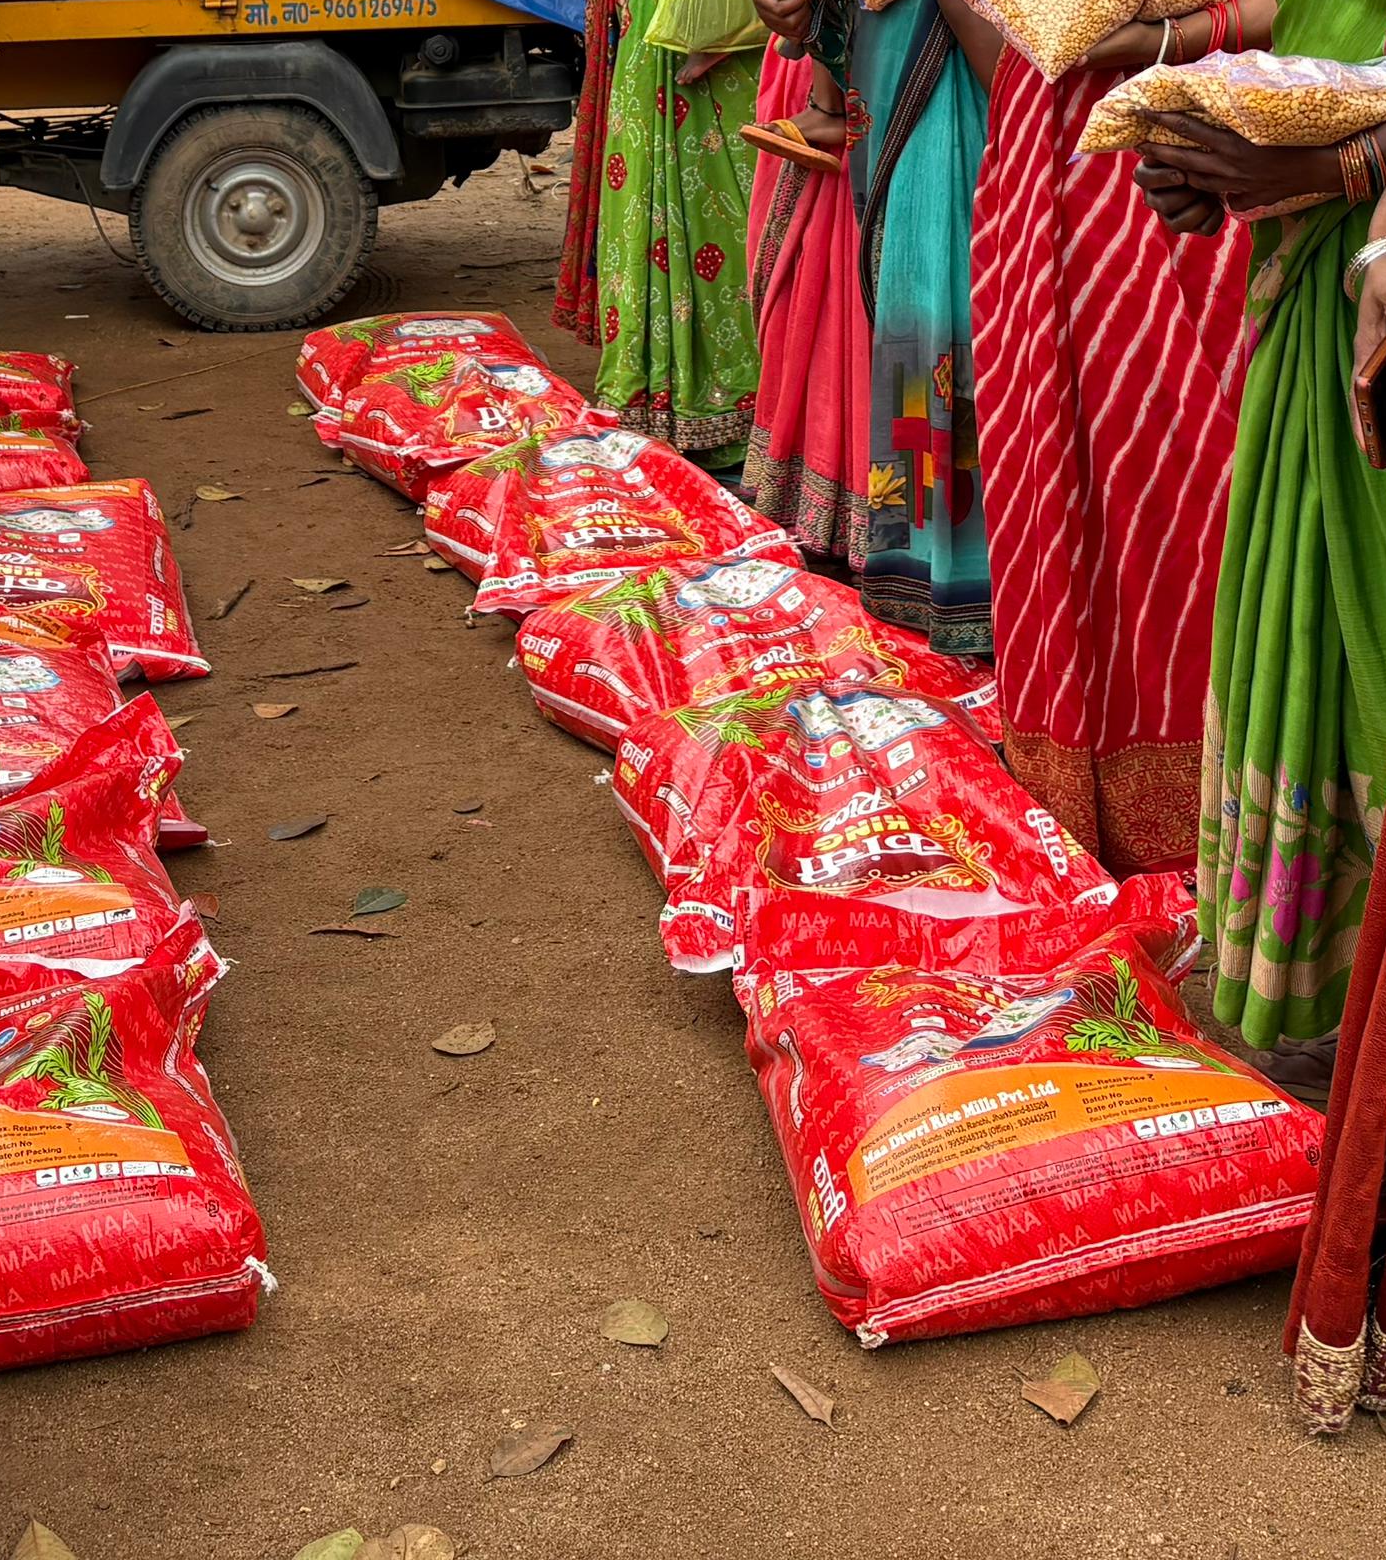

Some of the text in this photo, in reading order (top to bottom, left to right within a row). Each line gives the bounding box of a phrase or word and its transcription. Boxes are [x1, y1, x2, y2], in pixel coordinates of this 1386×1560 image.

[895, 767, 928, 797] BEST
[821, 788, 891, 832] Rice
[814, 813, 911, 852] KING
[850, 912, 893, 929] MAA
[816, 940, 860, 957] MAA
[1086, 1096, 1155, 1115] Date of Packing
[1110, 1091, 1123, 1099] No
[862, 1143, 890, 1167] Maa
[889, 1120, 930, 1152] Diwri
[929, 1108, 963, 1132] Rice
[961, 1096, 999, 1120] Mills
[997, 1087, 1030, 1108] Pvt.
[1028, 1079, 1062, 1100] Ltd.
[14, 1149, 25, 1159] of
[25, 1146, 63, 1158] Packing
[18, 1140, 33, 1148] No
[1188, 1162, 1243, 1197] MAA
[80, 1209, 140, 1242] MAA
[1113, 1192, 1166, 1226] MAA
[132, 1228, 190, 1262] MAA
[987, 1212, 1043, 1247] MAA
[1038, 1226, 1091, 1257] MAA
[50, 1256, 108, 1291] MAA
[914, 1248, 967, 1285] MAA
